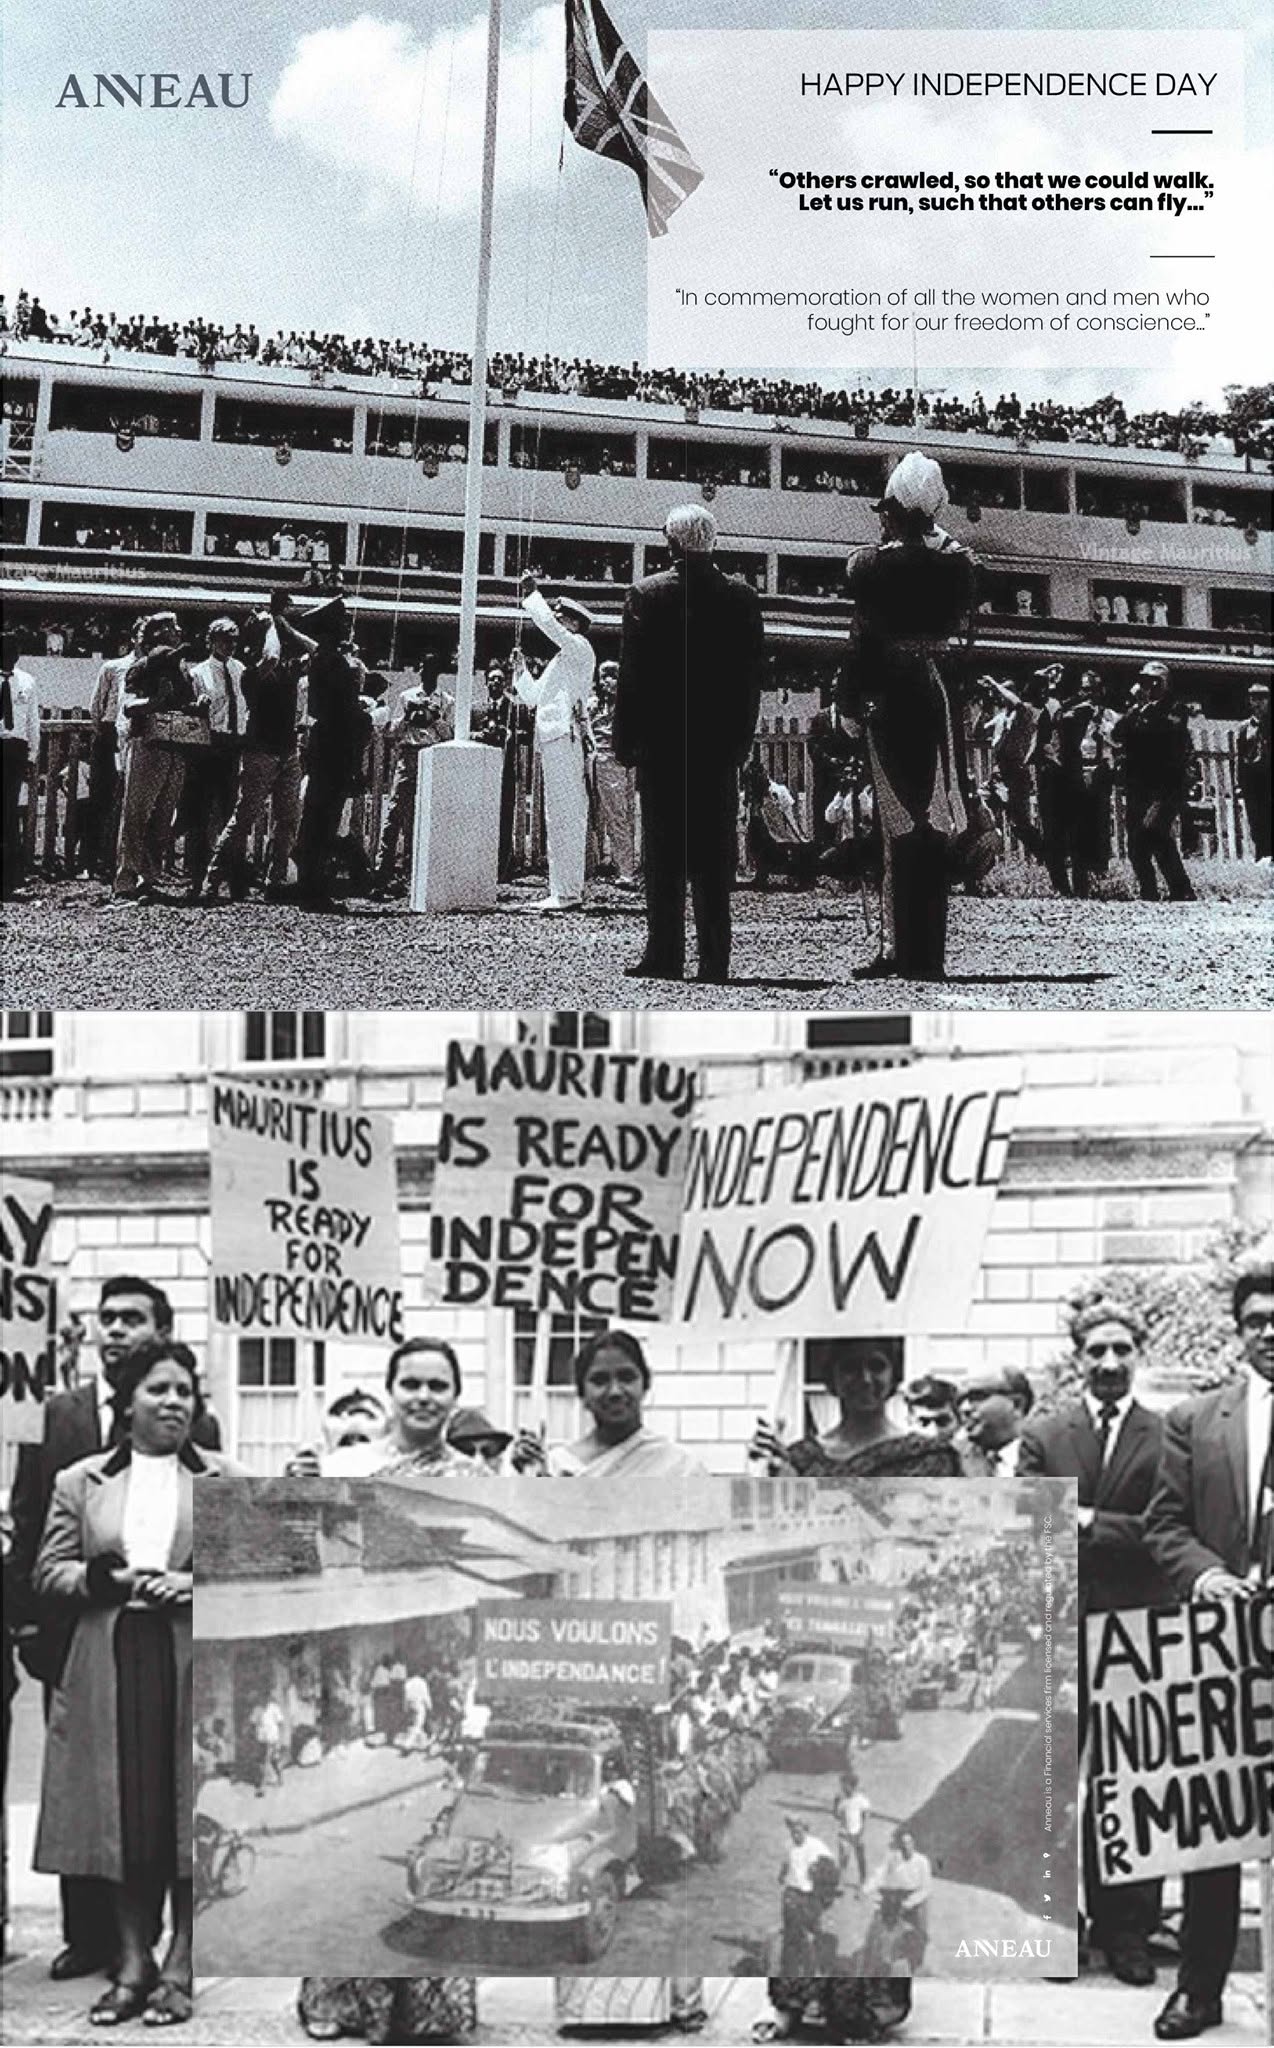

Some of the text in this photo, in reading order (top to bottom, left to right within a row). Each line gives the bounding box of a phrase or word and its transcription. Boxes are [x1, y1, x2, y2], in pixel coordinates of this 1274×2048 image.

[447, 1040, 697, 1118] MAURITIUS
[214, 1085, 372, 1168] MAURITIUS
[437, 1113, 682, 1177] IS READY
[684, 1090, 1020, 1212] INDEPENDENCE
[288, 1158, 320, 1201] IS
[511, 1175, 654, 1230] FOR
[264, 1199, 372, 1248] READY
[430, 1216, 680, 1279] INDEPEN
[286, 1239, 342, 1278] FOR
[683, 1215, 922, 1322] NOW
[215, 1272, 405, 1345] INDEPENDENCE
[442, 1261, 661, 1321] DENCE
[485, 1617, 658, 1645] NOUS VOULONS
